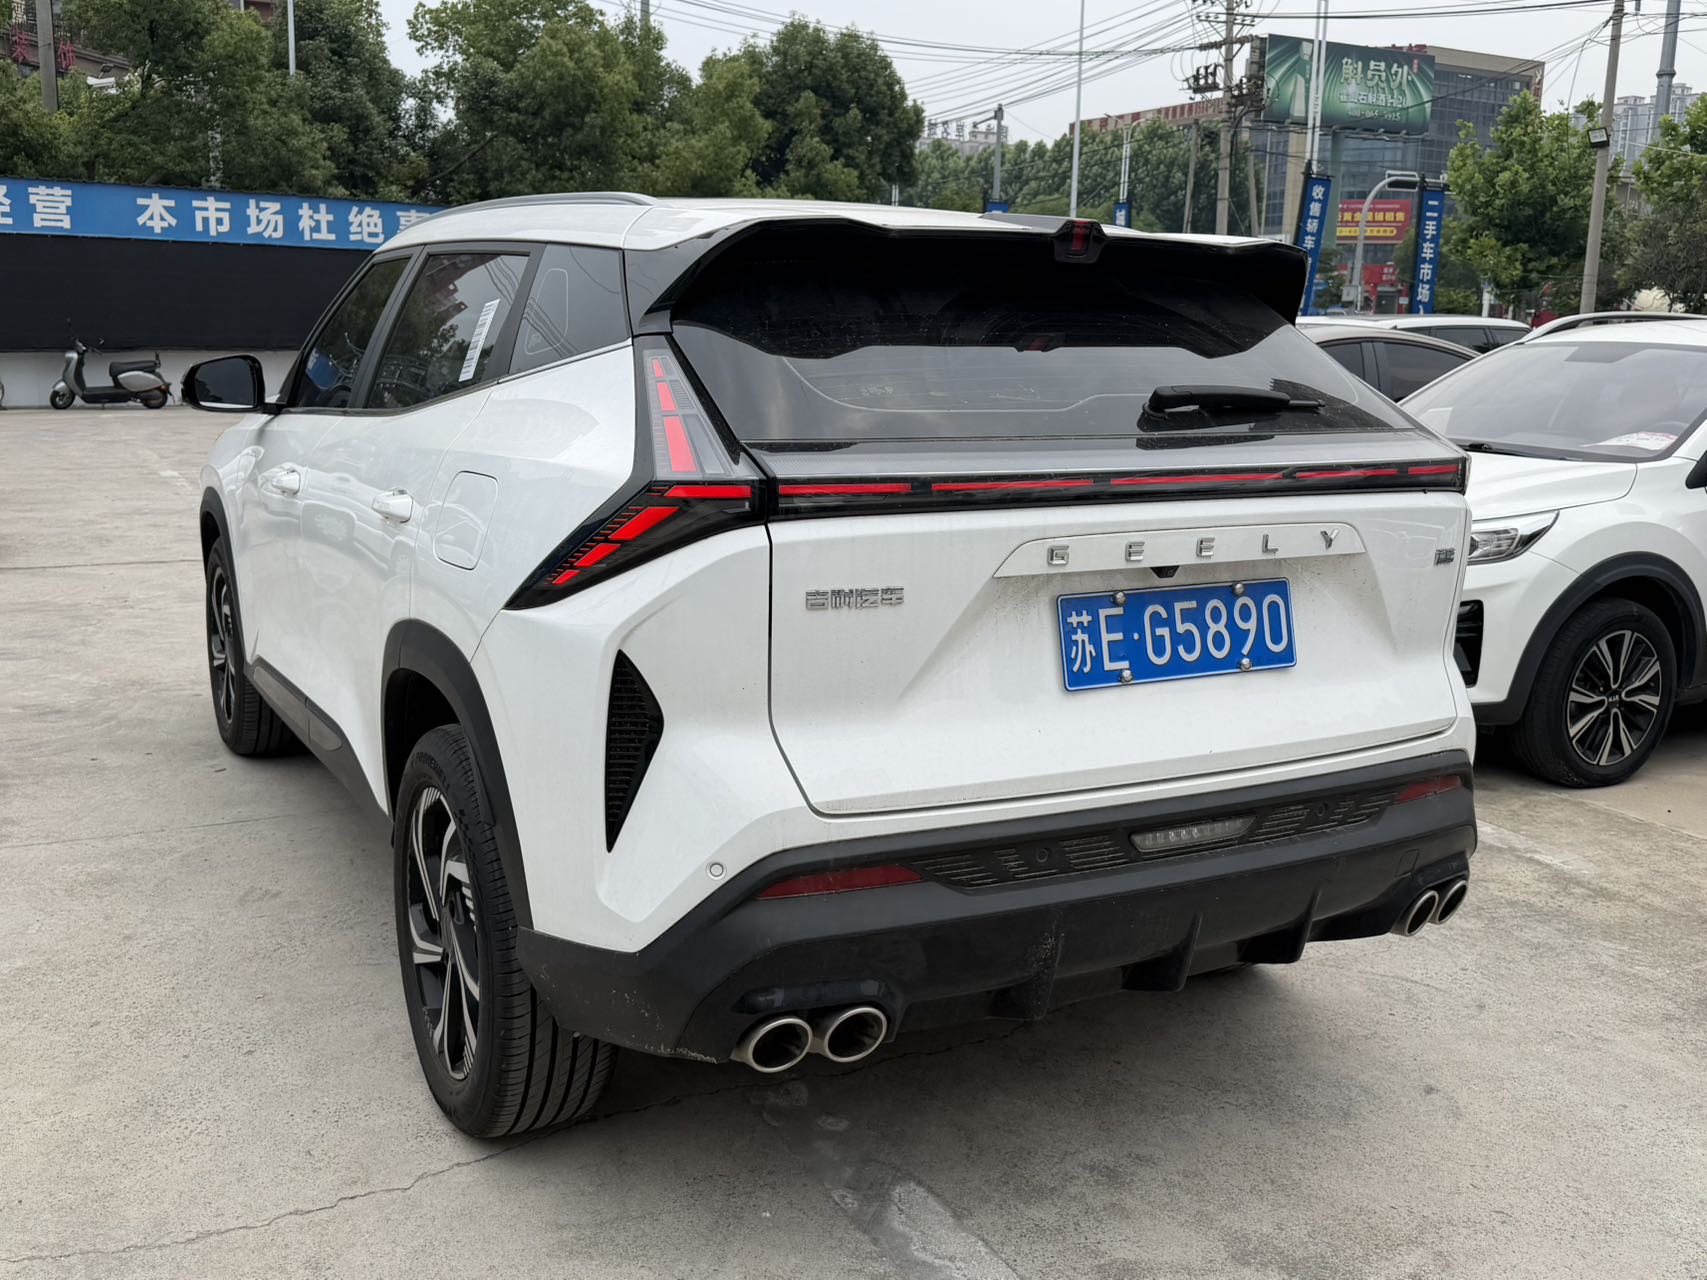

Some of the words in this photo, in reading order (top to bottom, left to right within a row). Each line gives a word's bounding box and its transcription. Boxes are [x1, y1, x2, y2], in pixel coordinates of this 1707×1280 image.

[1047, 527, 1340, 566] GEELY
[805, 586, 905, 611] 吉利汽车
[1066, 593, 1289, 674] 苏E·G5890
